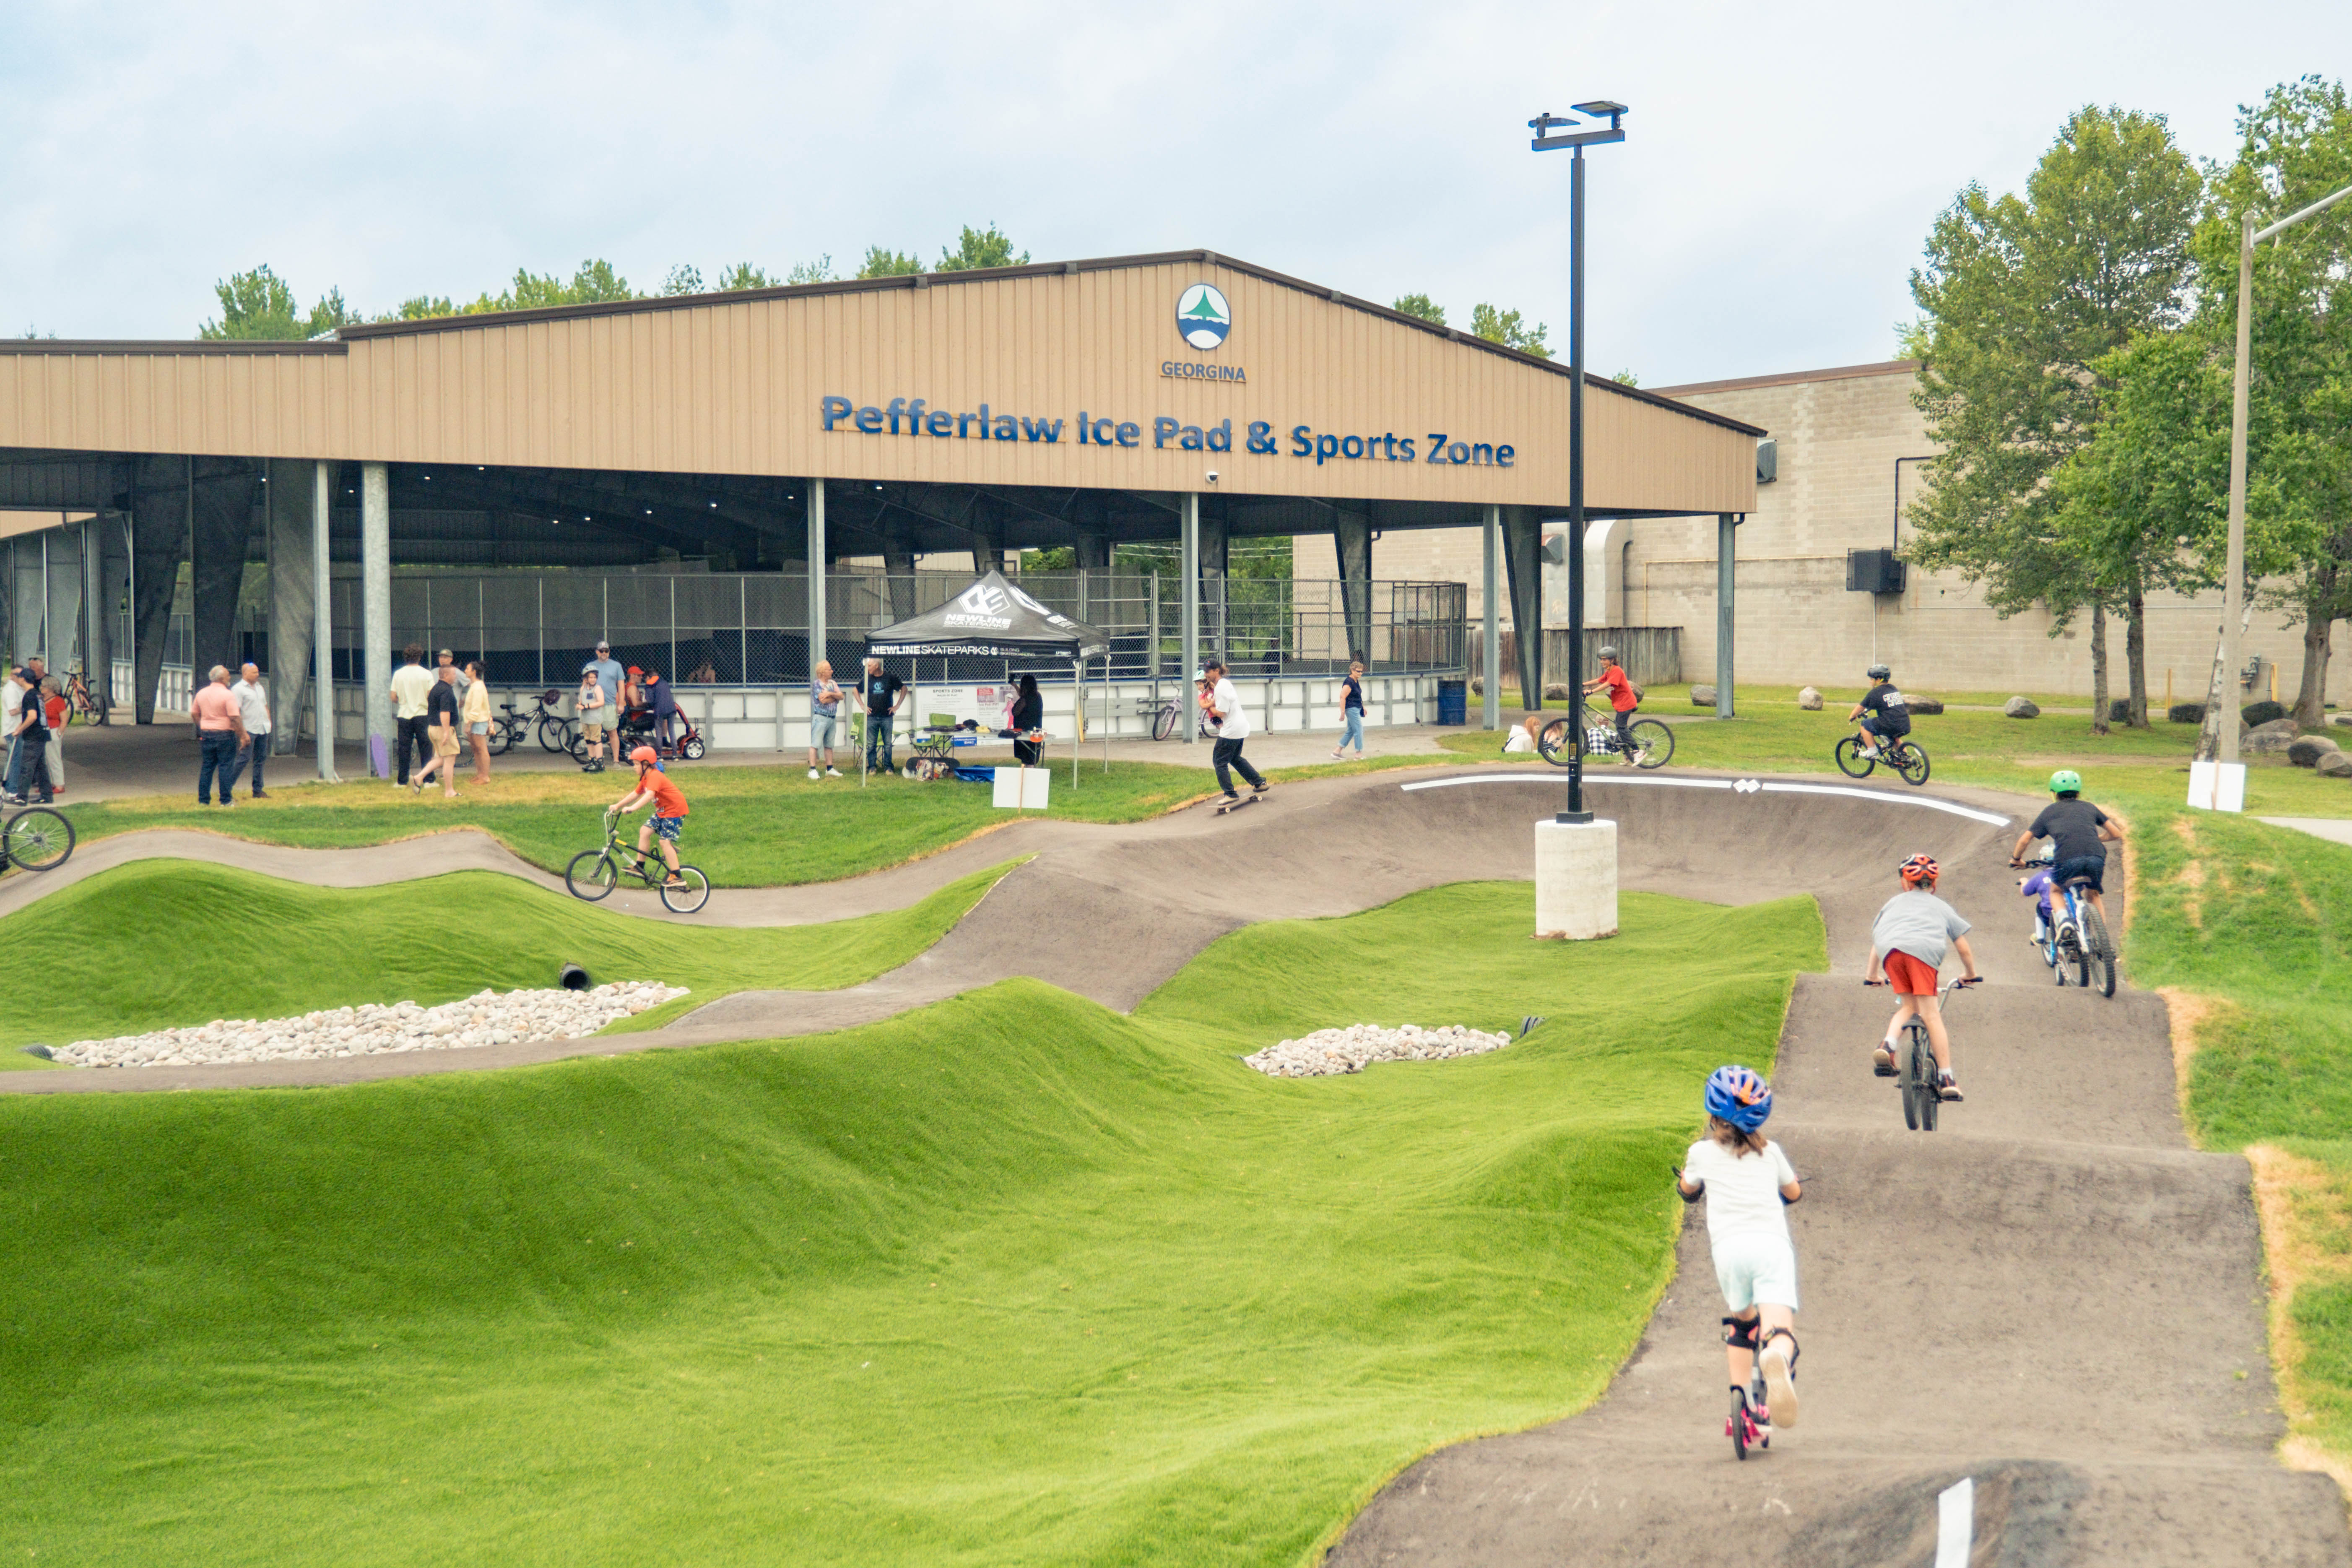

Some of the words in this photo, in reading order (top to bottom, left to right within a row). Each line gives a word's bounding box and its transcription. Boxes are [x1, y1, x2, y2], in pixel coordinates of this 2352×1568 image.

[1162, 361, 1246, 381] GEORGINA
[823, 396, 1063, 442] Pefferlaw
[1080, 411, 1140, 447] Ice
[1155, 416, 1231, 452] Pad
[1246, 421, 1278, 454] &
[1292, 425, 1415, 465] Sports
[1427, 434, 1515, 467] Zone
[944, 620, 1011, 629] SKATEPARKS
[946, 614, 1012, 624] NEWLINE
